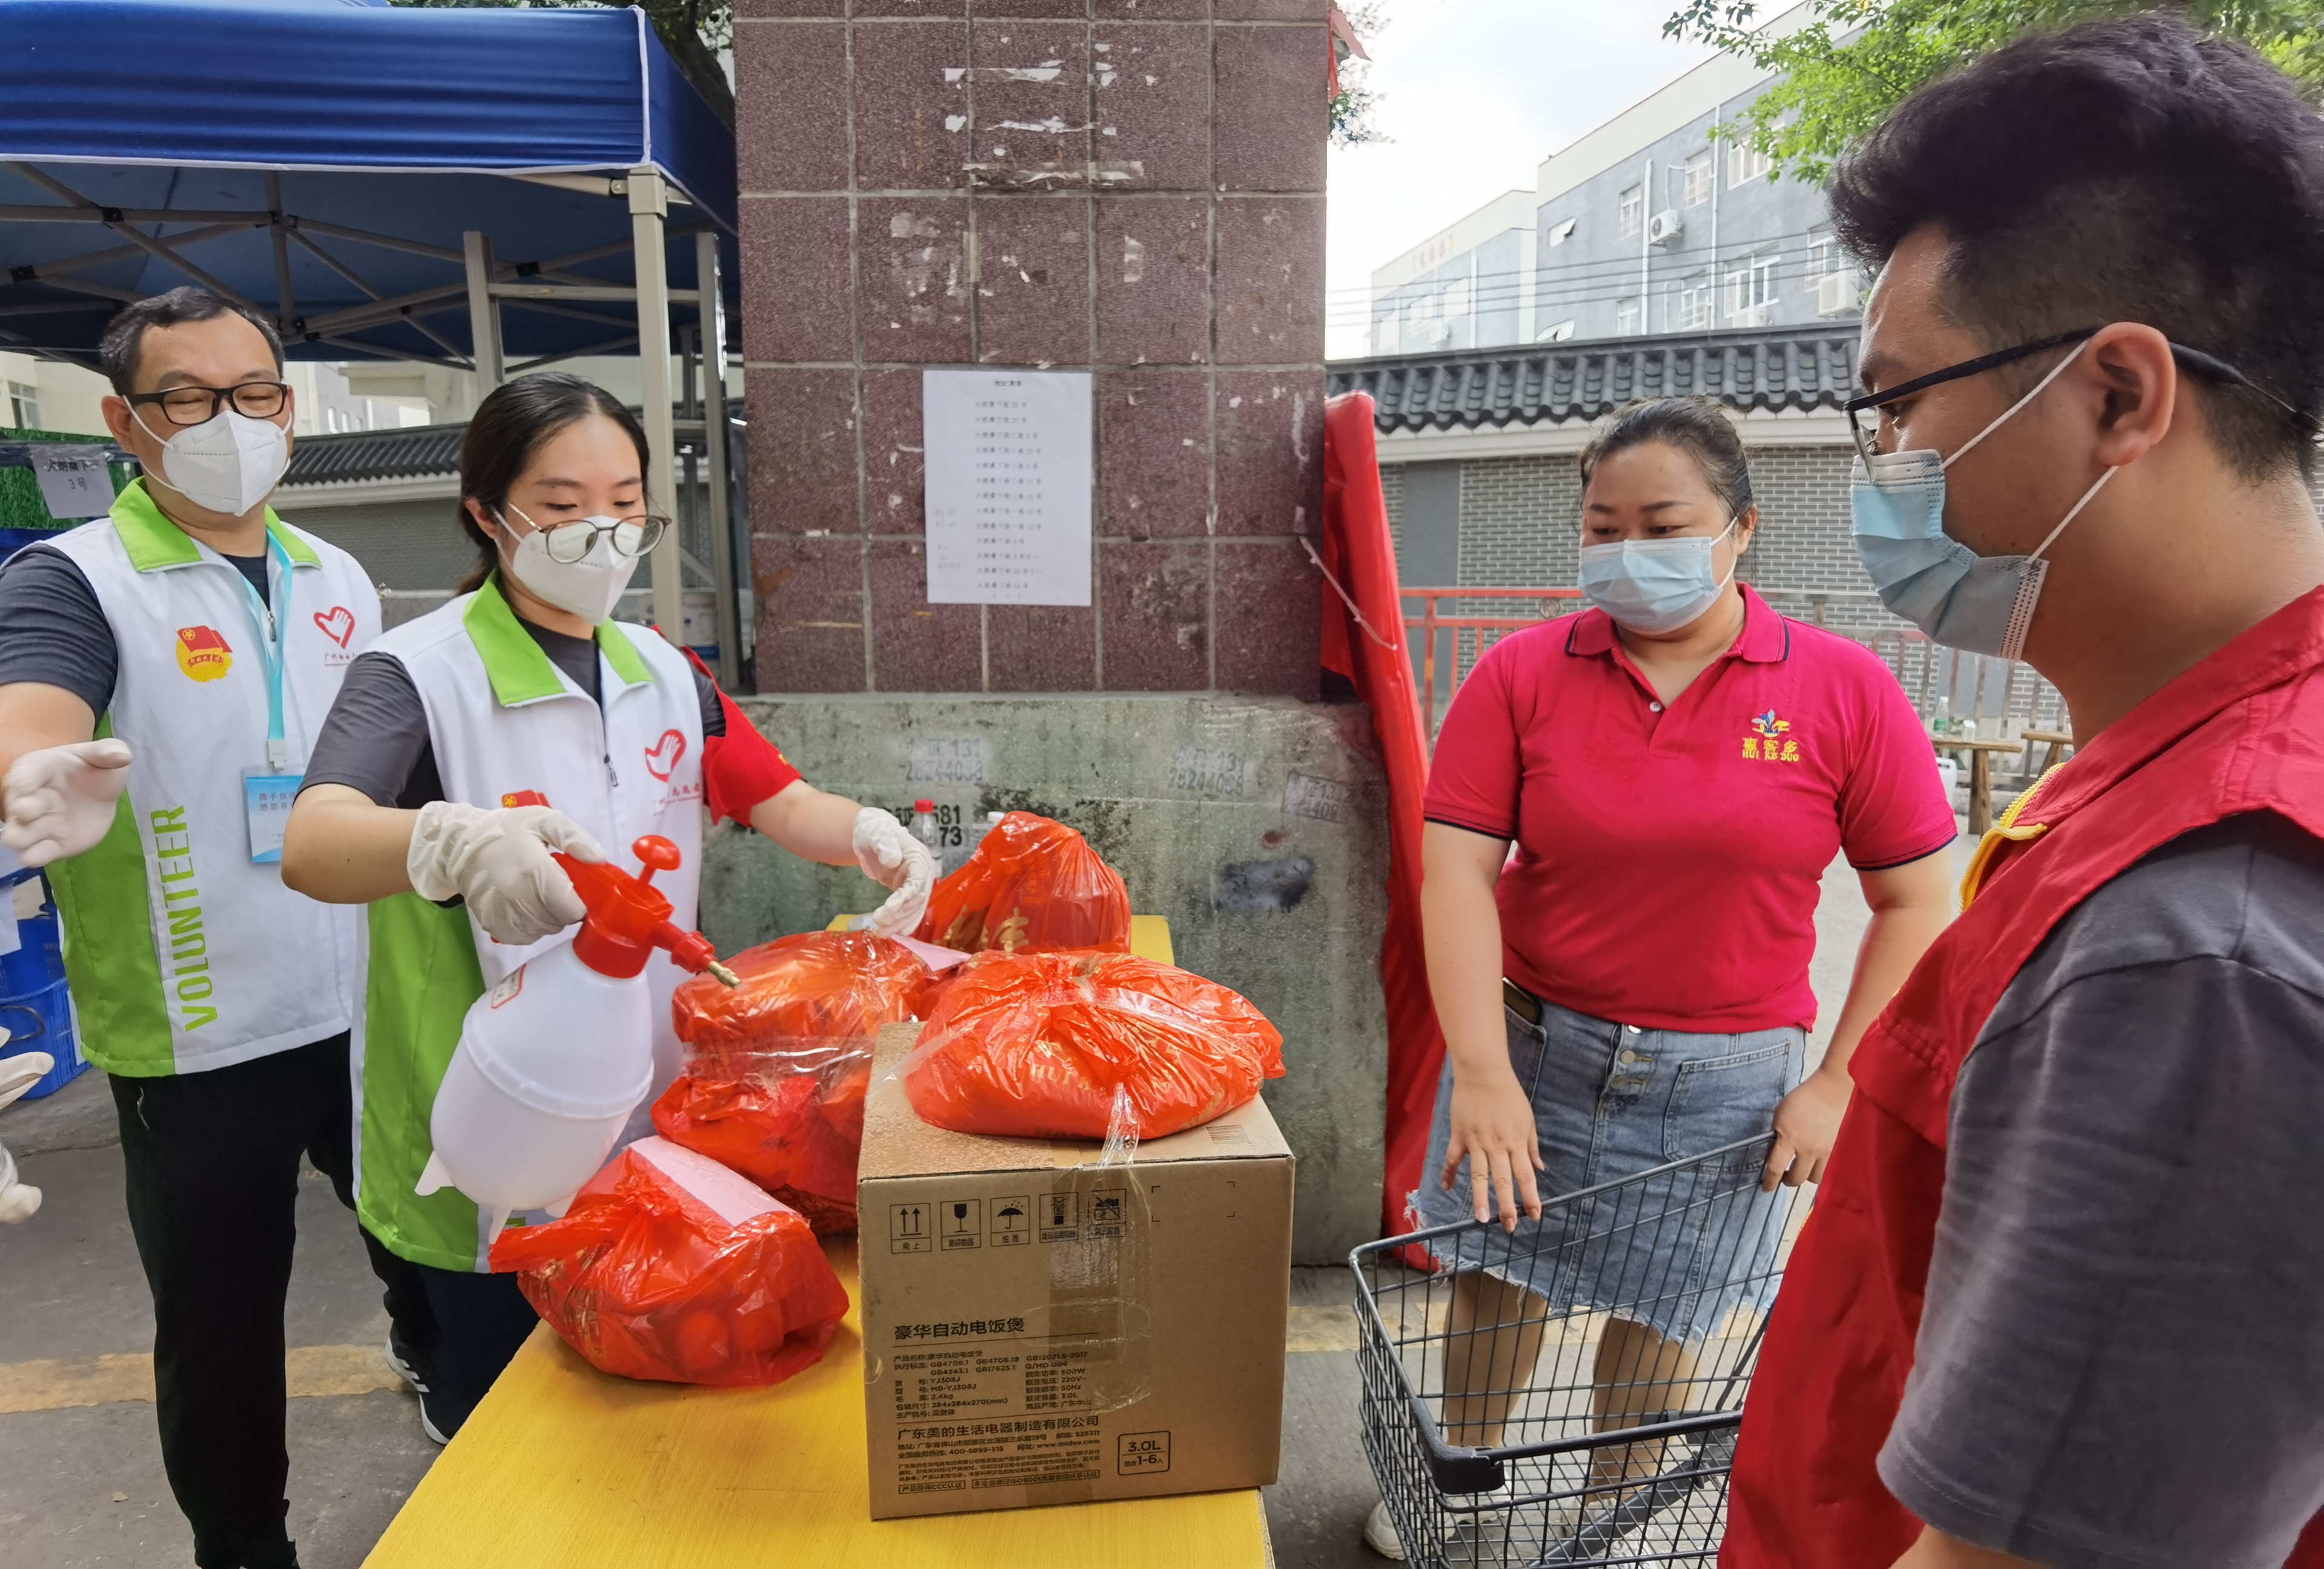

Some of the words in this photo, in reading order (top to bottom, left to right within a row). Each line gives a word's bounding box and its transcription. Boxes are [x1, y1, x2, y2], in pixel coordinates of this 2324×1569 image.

[151, 805, 218, 1032] VOLUNTEER
[894, 1318, 1025, 1340] 豪华自动电饭煲
[898, 1415, 1099, 1441] 广东美的生活电器制造有限公司
[1128, 1440, 1161, 1452] 3.0L
